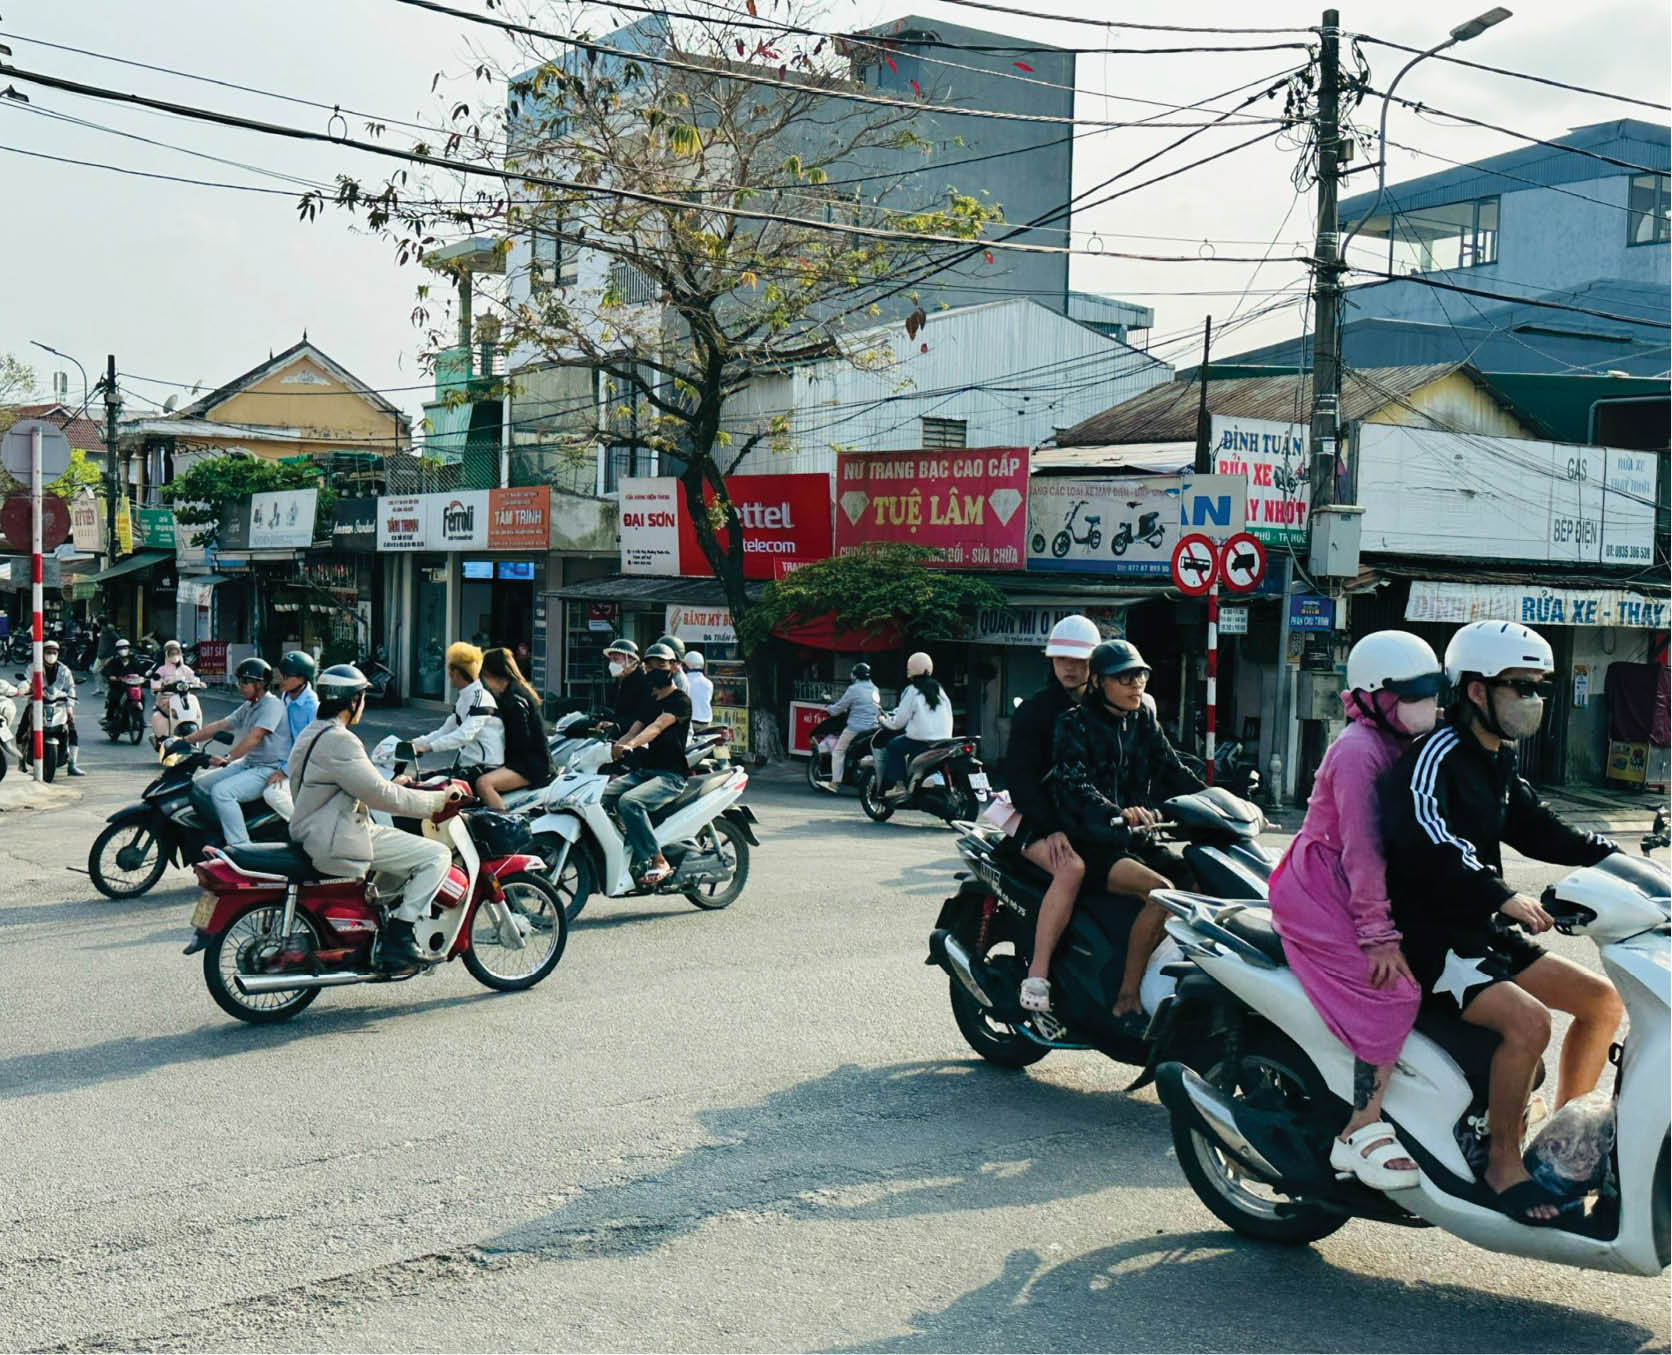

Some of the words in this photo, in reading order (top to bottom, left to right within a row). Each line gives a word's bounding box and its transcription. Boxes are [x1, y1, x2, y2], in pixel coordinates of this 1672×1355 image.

[869, 460, 915, 480] TRANG
[919, 458, 949, 482] BẠC
[953, 458, 984, 478] CAO
[988, 452, 1020, 477] CẤP
[1253, 463, 1273, 487] XE
[1567, 458, 1588, 481] GAS
[623, 512, 644, 531] ĐẠI
[647, 511, 675, 528] SƠN
[873, 487, 922, 533] TUỆ
[929, 485, 985, 526] LÂM
[1264, 494, 1306, 525] NHỚT
[742, 538, 796, 553] telecom
[1521, 589, 1565, 622] RỬA
[1570, 599, 1598, 624] XE
[1616, 601, 1665, 625] THAY
